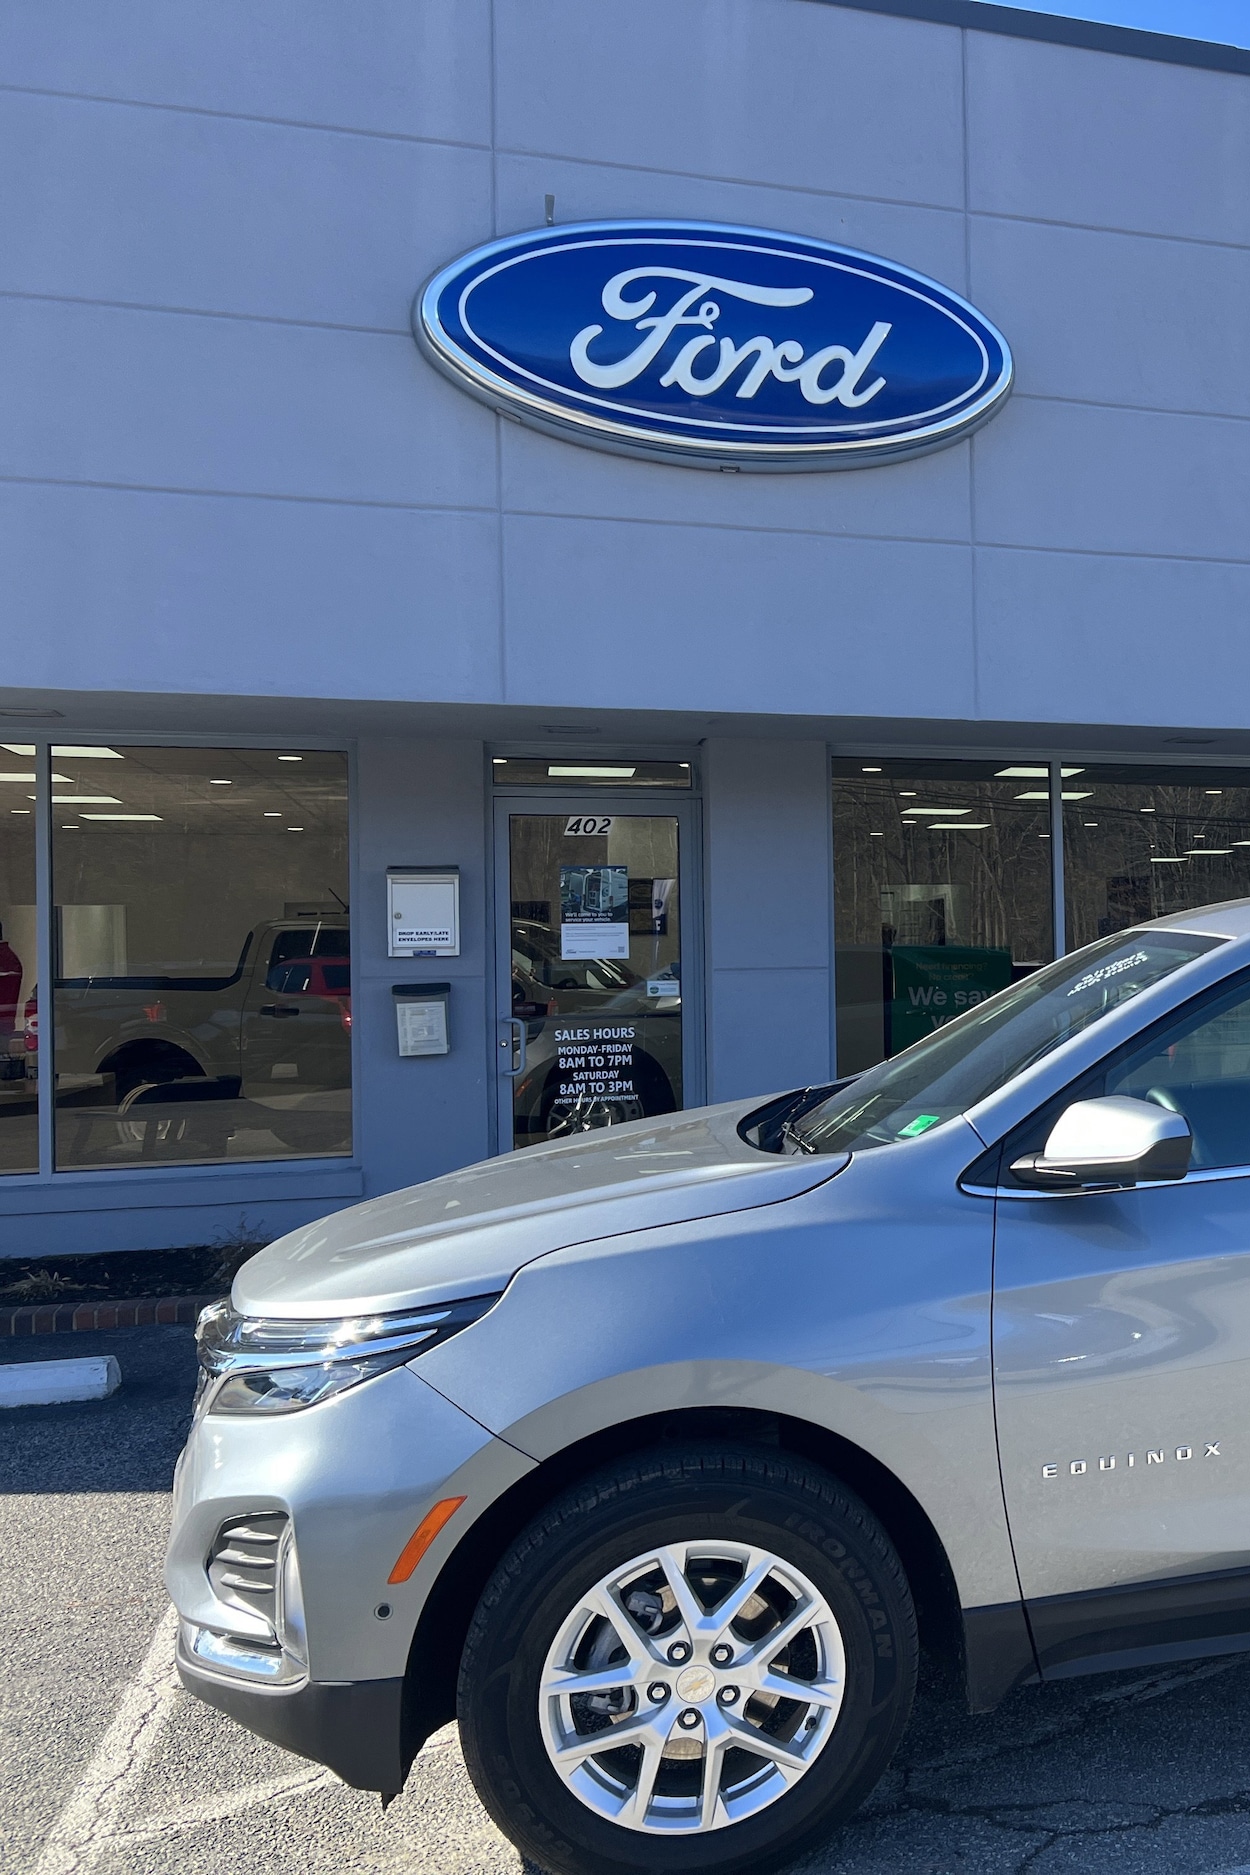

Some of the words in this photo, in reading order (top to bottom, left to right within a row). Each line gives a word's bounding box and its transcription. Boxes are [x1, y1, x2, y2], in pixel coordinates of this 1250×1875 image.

[569, 265, 892, 408] Ford
[567, 818, 611, 834] 402
[916, 962, 940, 971] Need
[929, 973, 942, 981] No
[907, 986, 947, 1006] We
[554, 1029, 590, 1041] SALES
[593, 1027, 635, 1039] HOURS
[558, 1044, 633, 1055] MONDAY-FRIDAY
[559, 1057, 585, 1069] 8AM
[588, 1056, 604, 1067] TO
[607, 1055, 632, 1066] 7PM
[572, 1070, 620, 1081] SATURDAY
[559, 1082, 586, 1095] 8AM
[588, 1082, 605, 1093] TO
[608, 1080, 633, 1092] 3PM
[554, 1097, 573, 1105] OTHER
[600, 1094, 639, 1102] APPOINTMENT
[1042, 1440, 1221, 1478] EQUINOX
[784, 1512, 893, 1658] IRONMAN
